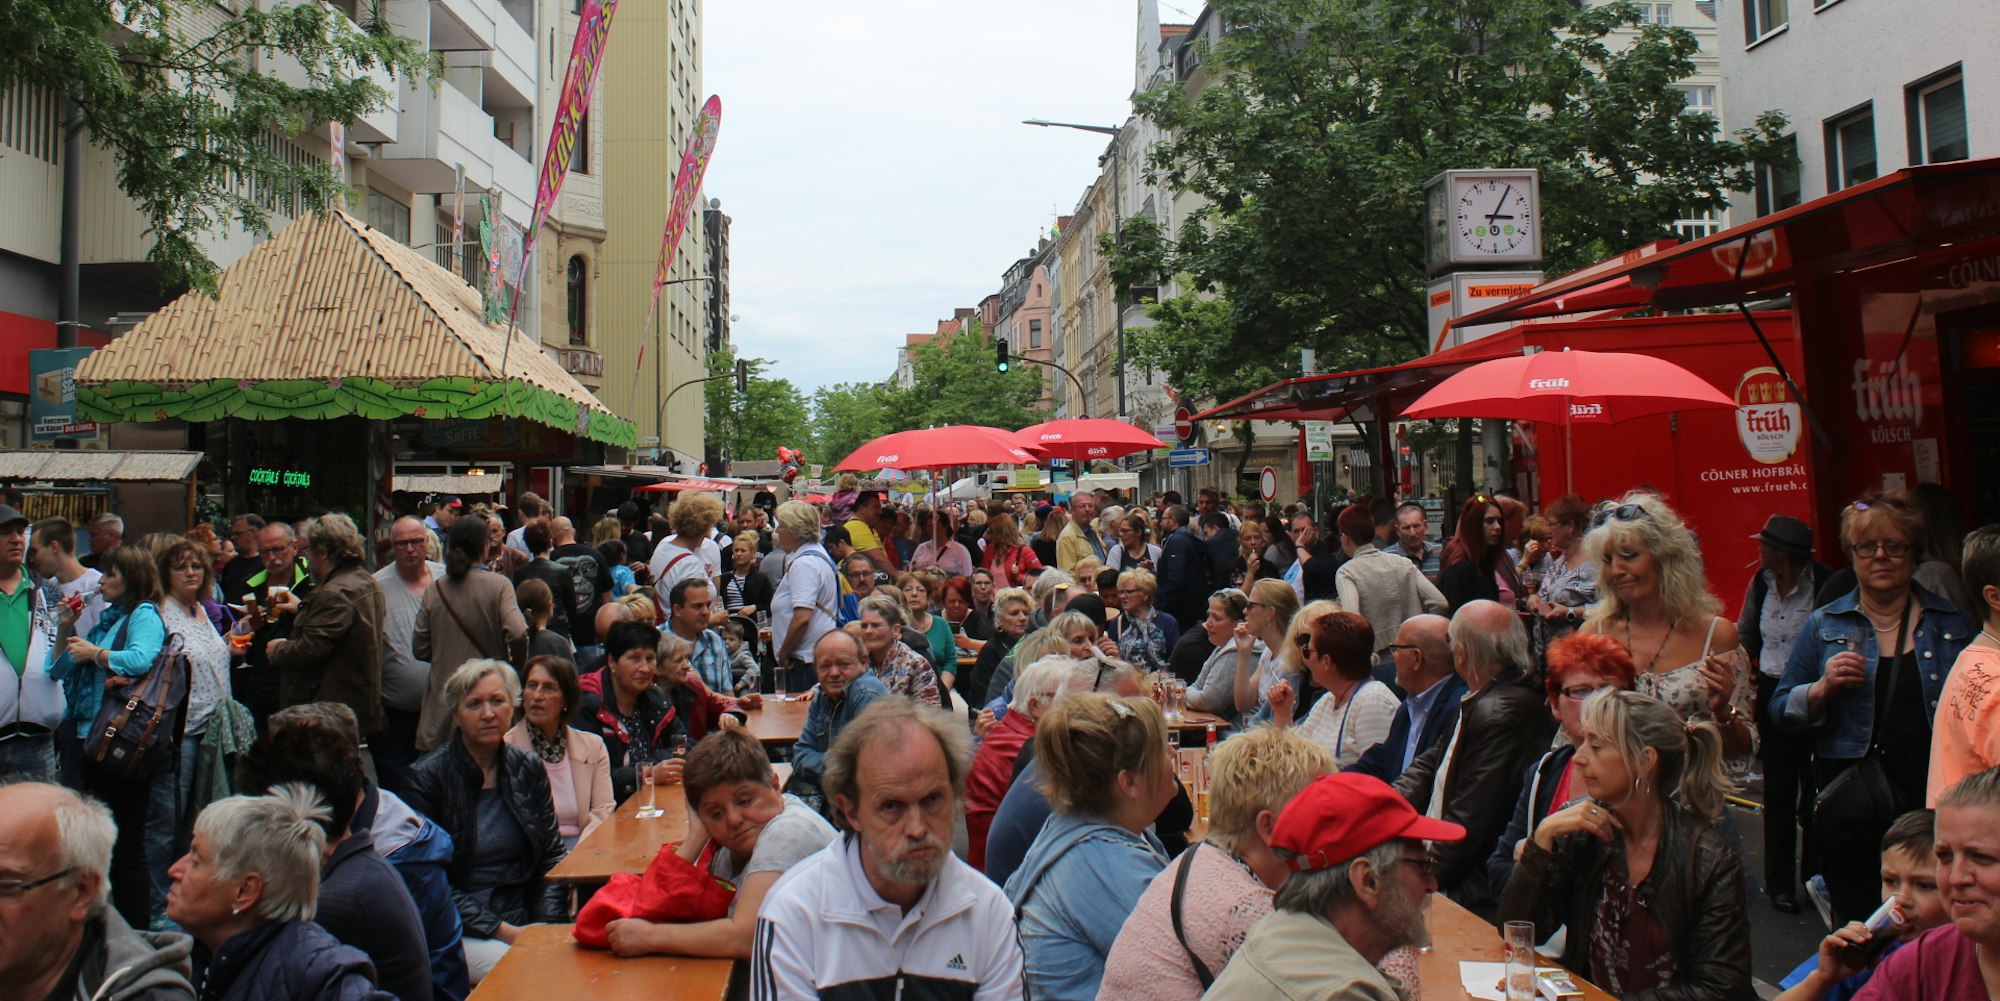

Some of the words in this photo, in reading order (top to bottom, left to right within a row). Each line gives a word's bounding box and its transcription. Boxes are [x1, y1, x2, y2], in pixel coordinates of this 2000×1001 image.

[548, 3, 613, 193] COCKTAILS
[1470, 287, 1482, 297] Zu
[62, 379, 76, 393] SC
[1528, 377, 1570, 388] früh
[1852, 350, 1923, 429] früh
[1746, 407, 1791, 433] früh
[1871, 425, 1911, 443] KÖLSCH
[1700, 468, 1748, 482] CÖLNER
[946, 962, 967, 971] adidas
